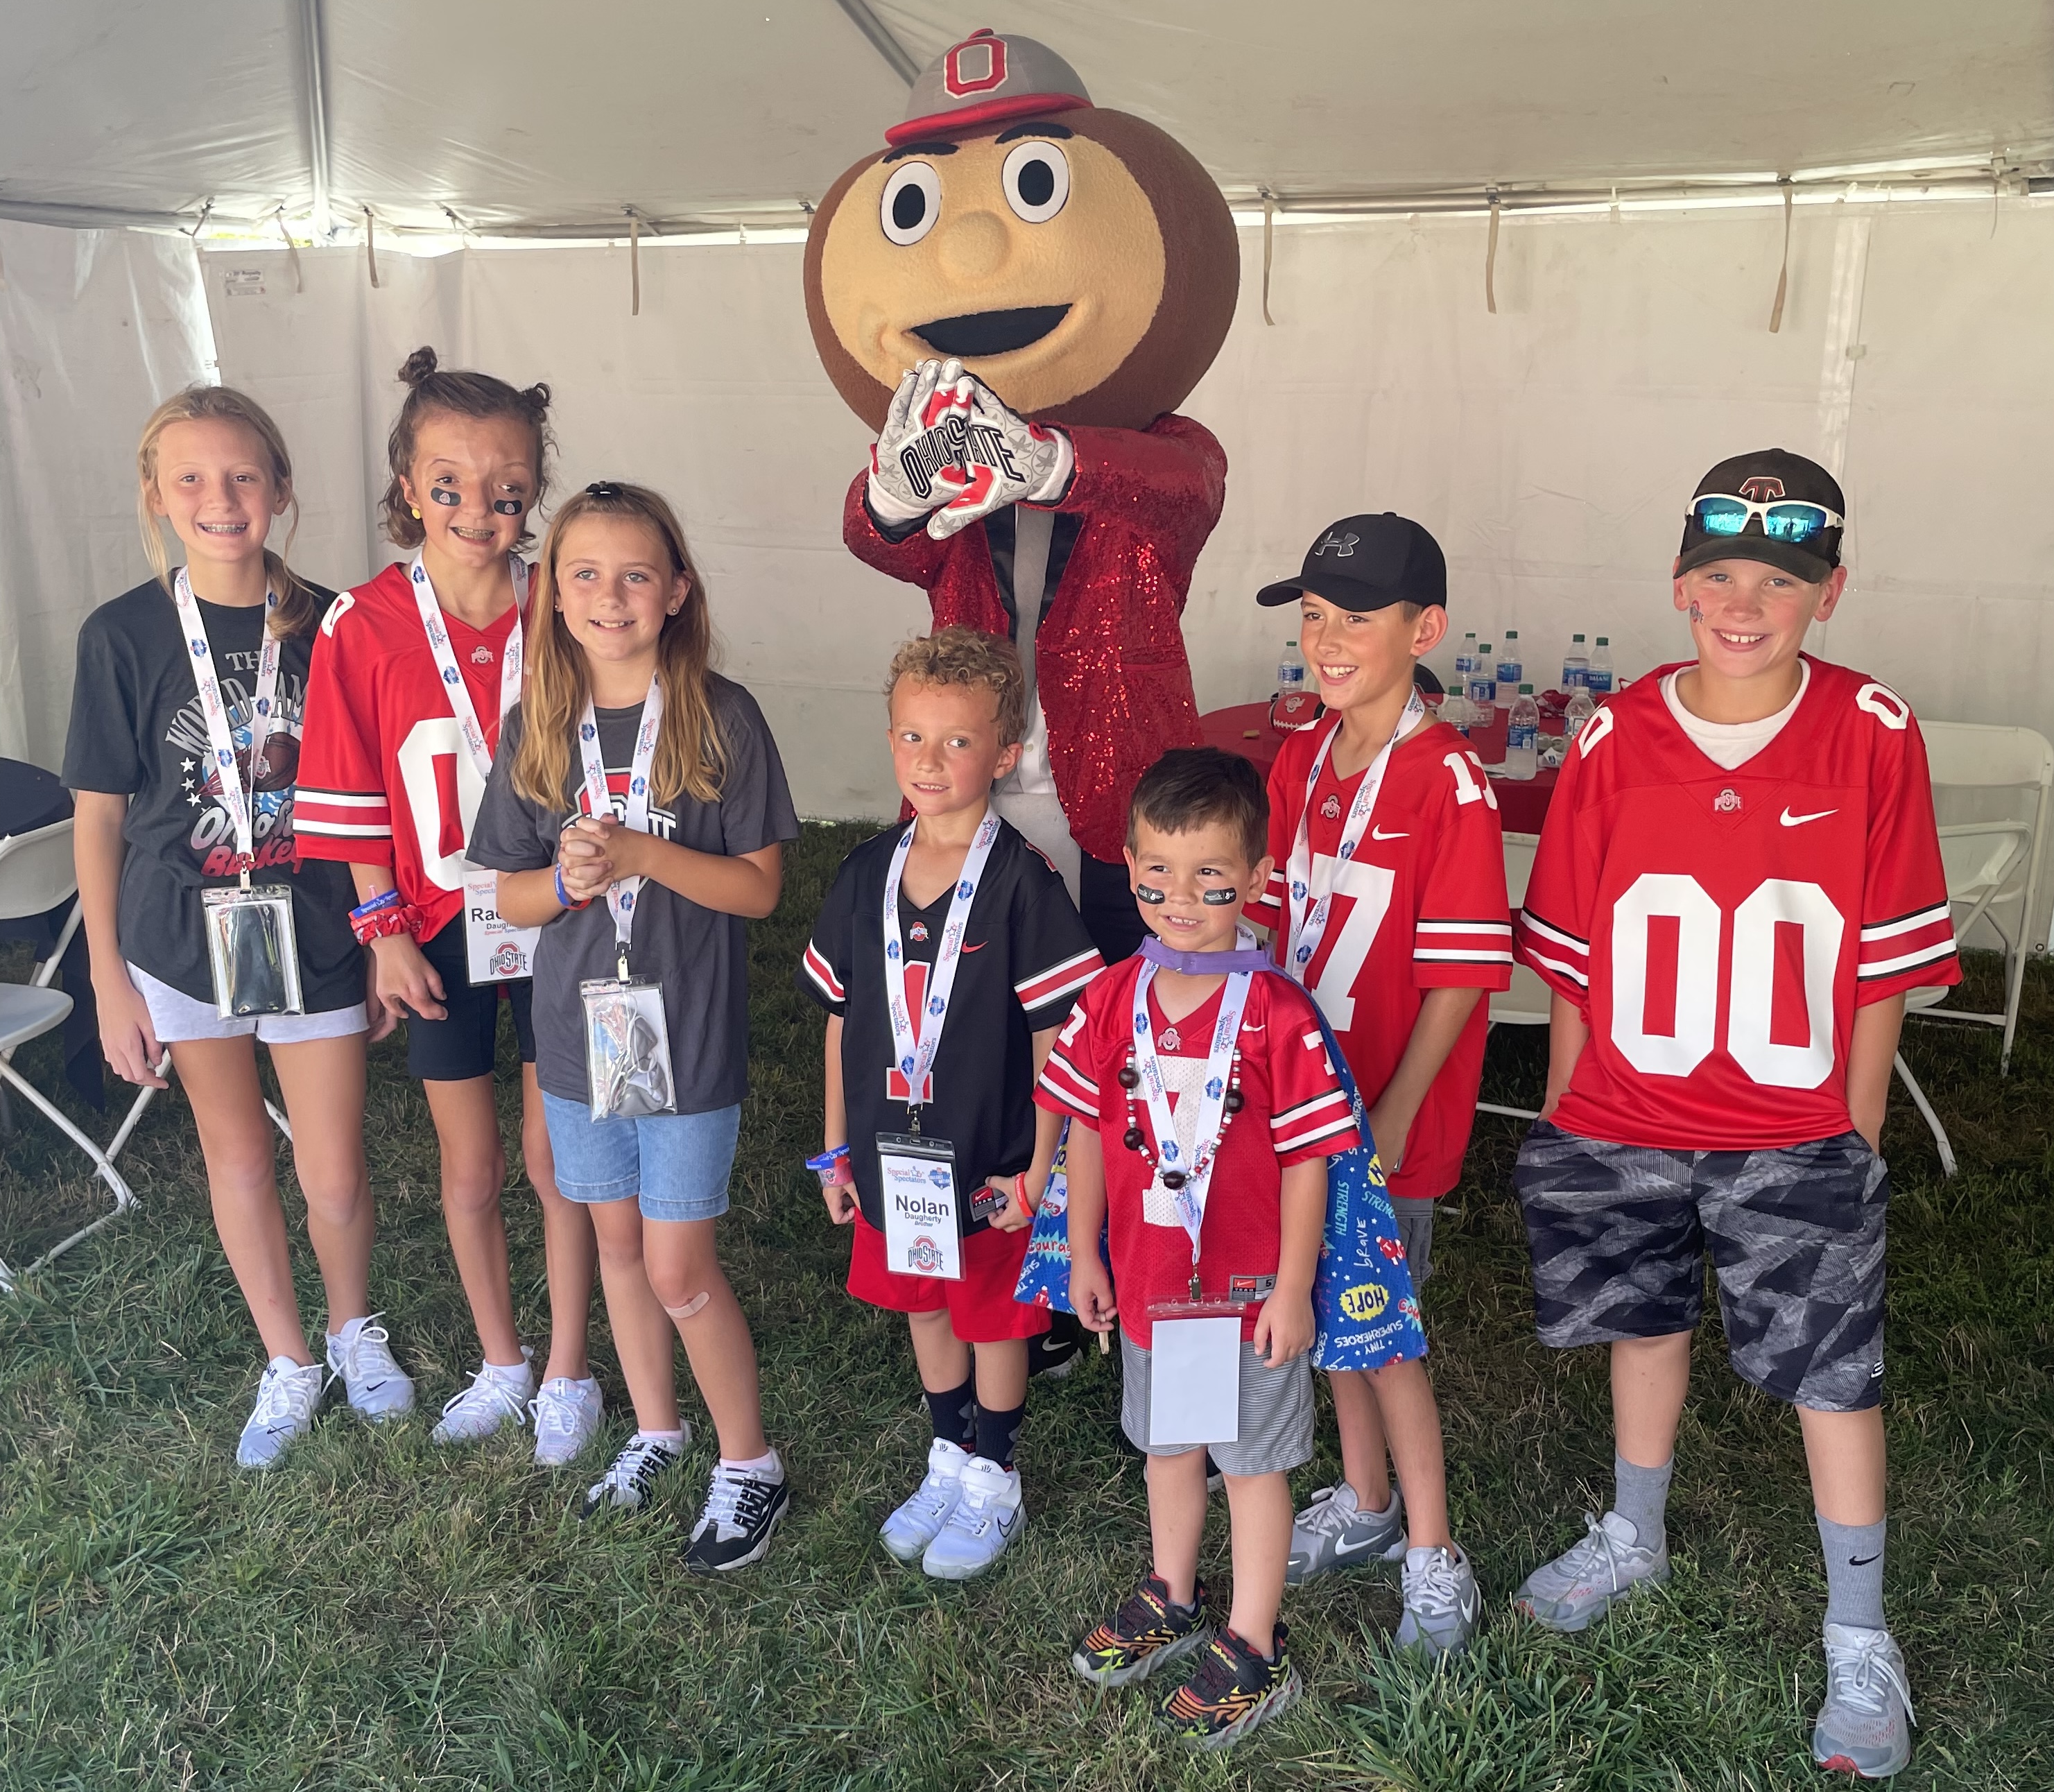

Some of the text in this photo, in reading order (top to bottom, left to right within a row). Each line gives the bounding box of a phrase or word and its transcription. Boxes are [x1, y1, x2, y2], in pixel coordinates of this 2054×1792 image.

[944, 37, 1008, 99] O
[1738, 476, 1786, 502] T
[225, 651, 270, 671] TH
[1855, 682, 1909, 730] 0
[637, 723, 648, 755] Spectators
[644, 718, 655, 741] Special
[1578, 706, 1614, 761] 0
[1352, 784, 1367, 818] Spectators
[1363, 779, 1376, 803] Special
[944, 938, 953, 962] Special
[951, 922, 963, 956] Spectators
[1286, 852, 1396, 1032] 7
[1610, 873, 1845, 1089] 00
[891, 1002, 900, 1036] Spectators
[1058, 1003, 1087, 1048] 7
[1224, 1010, 1236, 1035] Special
[1214, 1016, 1227, 1053] Spectators
[917, 1053, 927, 1076] Special
[924, 1037, 936, 1069] Spectators
[1150, 1056, 1162, 1093] Spectators
[1149, 1075, 1159, 1102] Special
[888, 1167, 910, 1177] Special
[894, 1175, 926, 1184] Spectators
[896, 1194, 949, 1216] Nolan
[904, 1212, 942, 1224] Daugherty
[1183, 1201, 1195, 1227] Special
[1335, 1180, 1349, 1236] STRENGTH
[1266, 1279, 1272, 1287] 5
[1345, 1287, 1385, 1313] HOPE
[1334, 1320, 1403, 1348] SUPERHEROES
[1365, 1339, 1386, 1355] TINY
